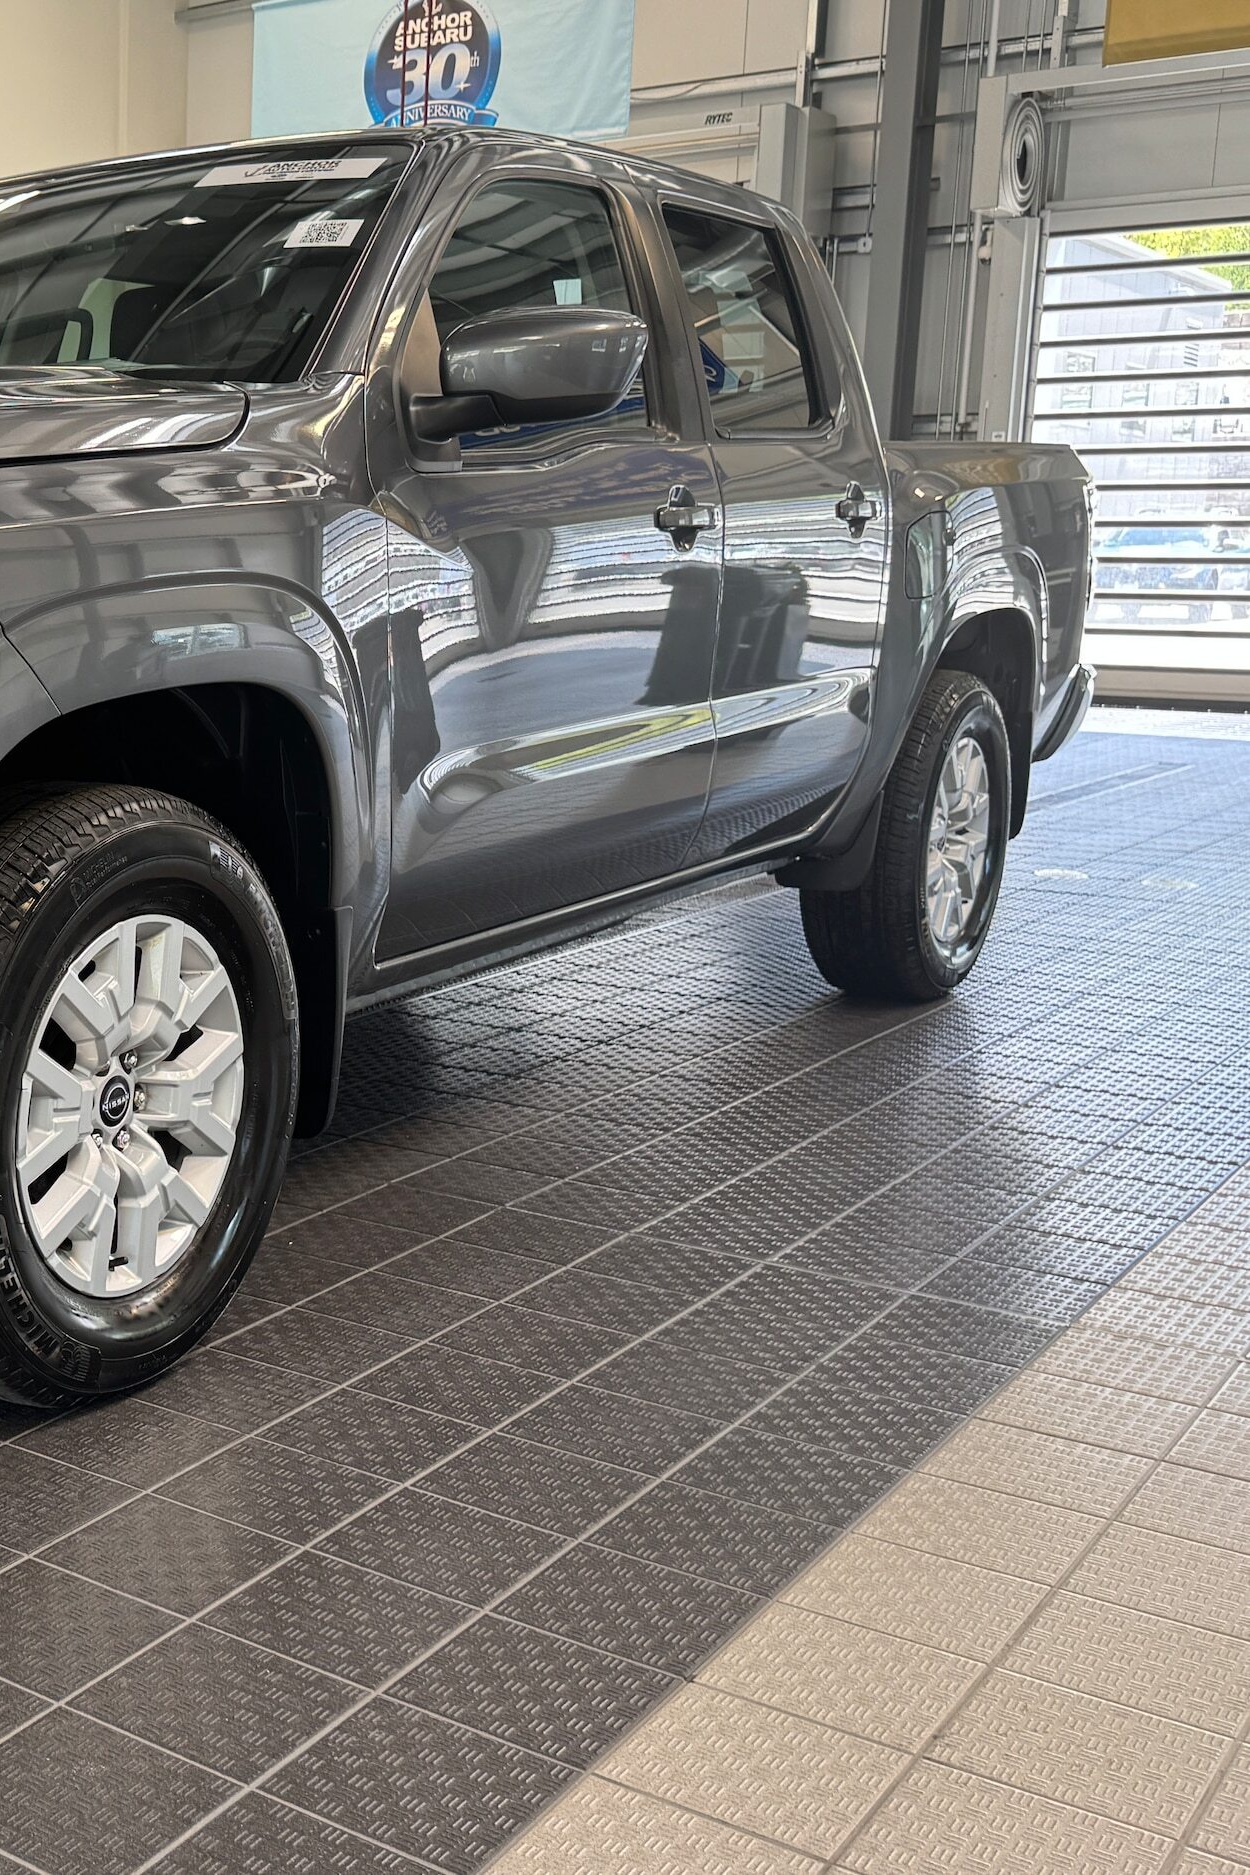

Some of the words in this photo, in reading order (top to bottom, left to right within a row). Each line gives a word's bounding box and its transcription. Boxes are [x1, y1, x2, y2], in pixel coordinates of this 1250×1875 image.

[395, 11, 472, 37] ANCHOR
[394, 26, 473, 52] SUBARU
[704, 112, 733, 125] RYTEC
[102, 1092, 130, 1111] NISSAN
